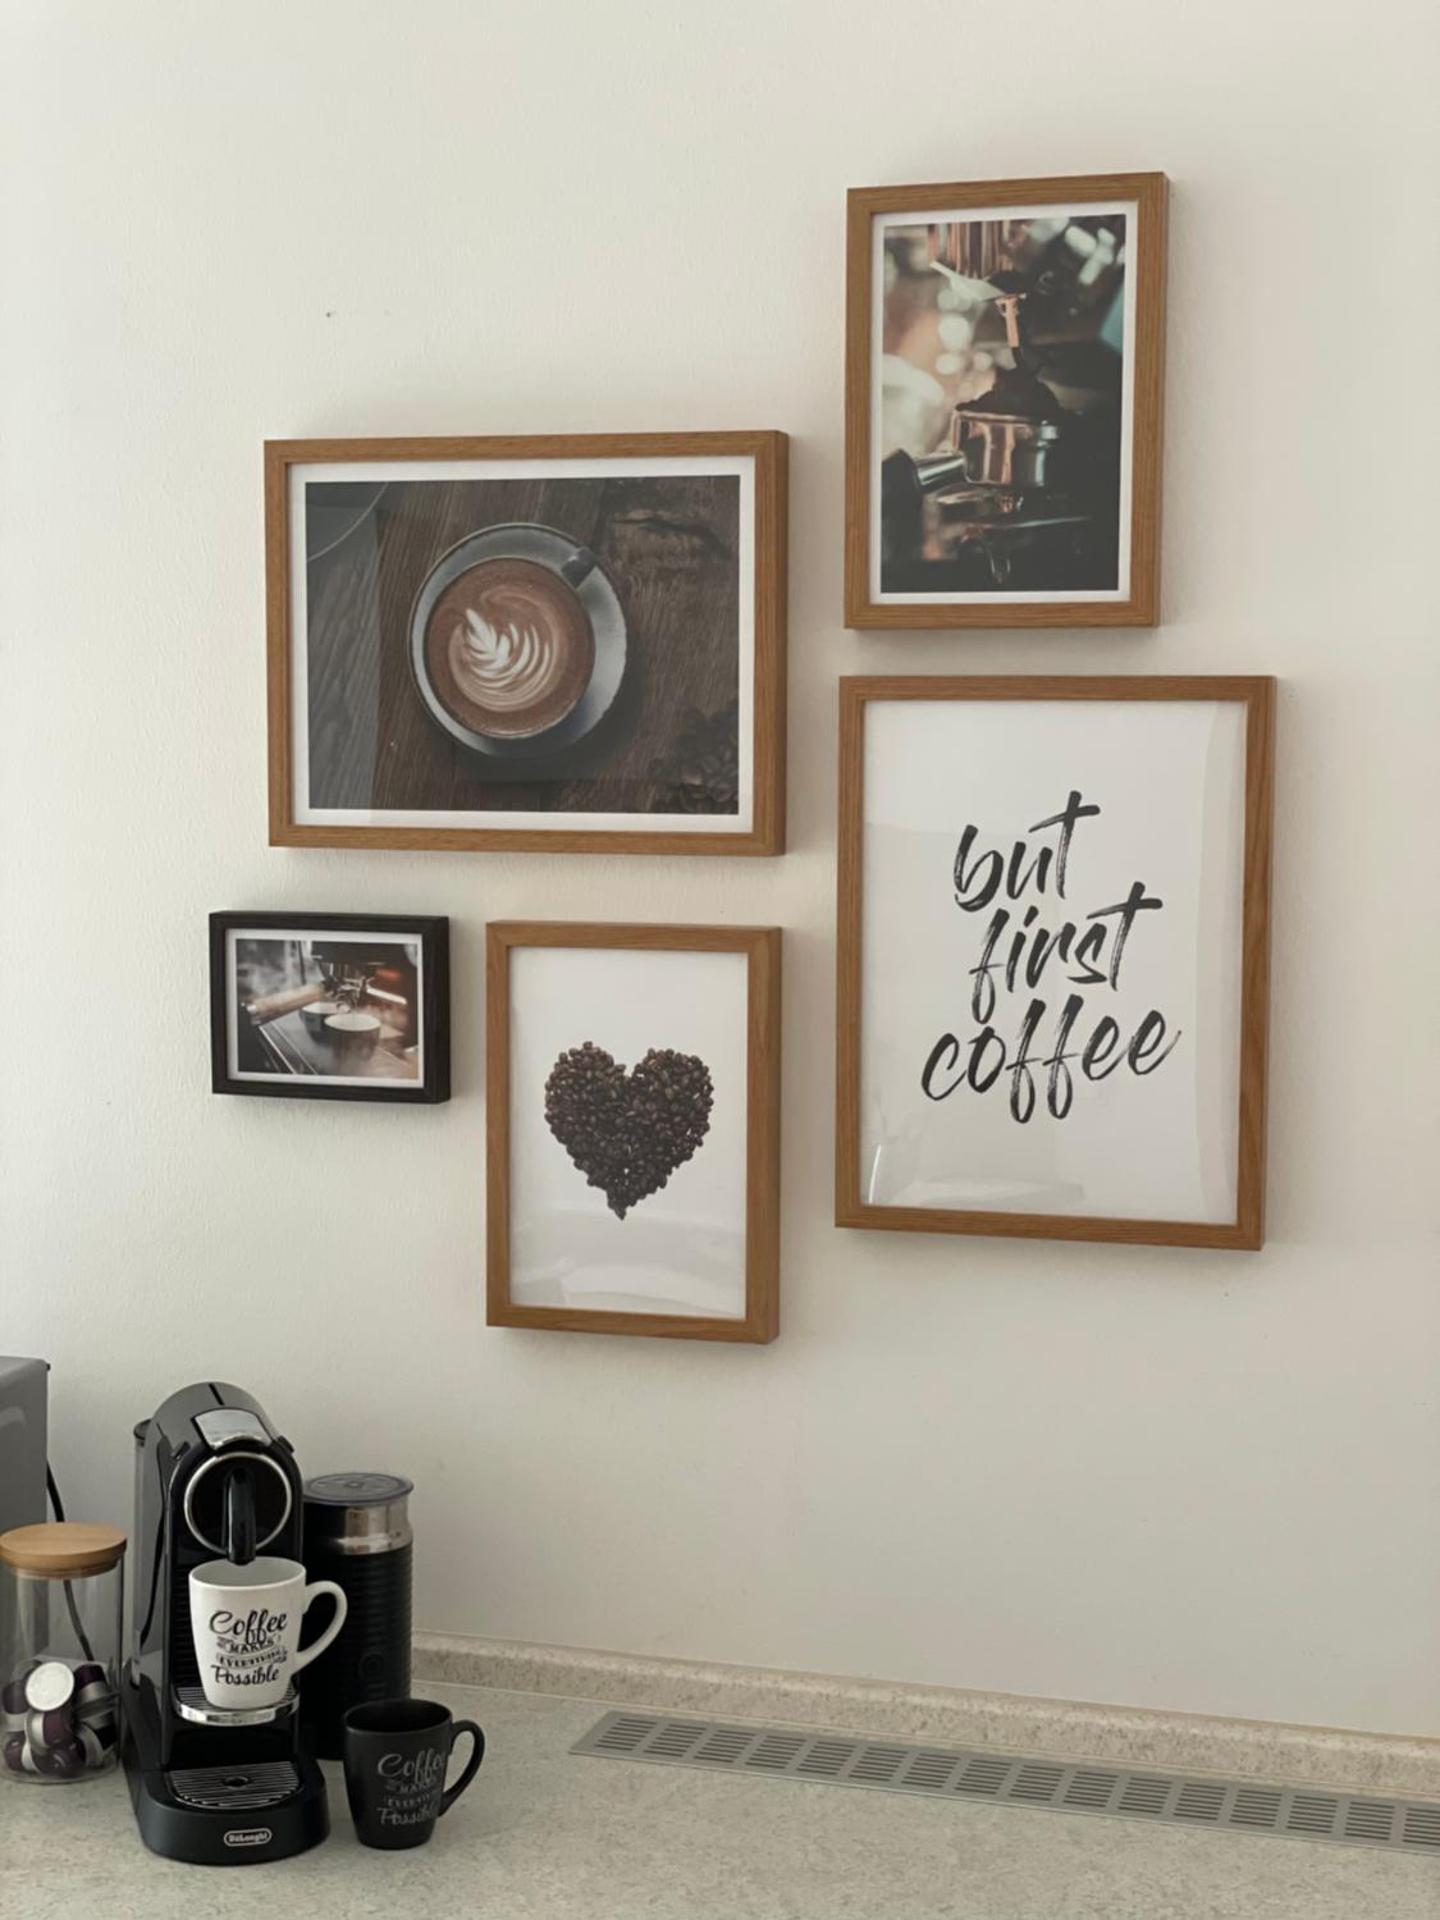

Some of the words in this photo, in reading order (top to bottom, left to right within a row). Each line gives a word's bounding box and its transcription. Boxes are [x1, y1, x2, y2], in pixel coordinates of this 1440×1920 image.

[953, 790, 1100, 912] but
[969, 881, 1162, 1024] first
[921, 994, 1182, 1124] coffee
[209, 1608, 288, 1645] Coffee
[211, 1664, 280, 1685] Possible
